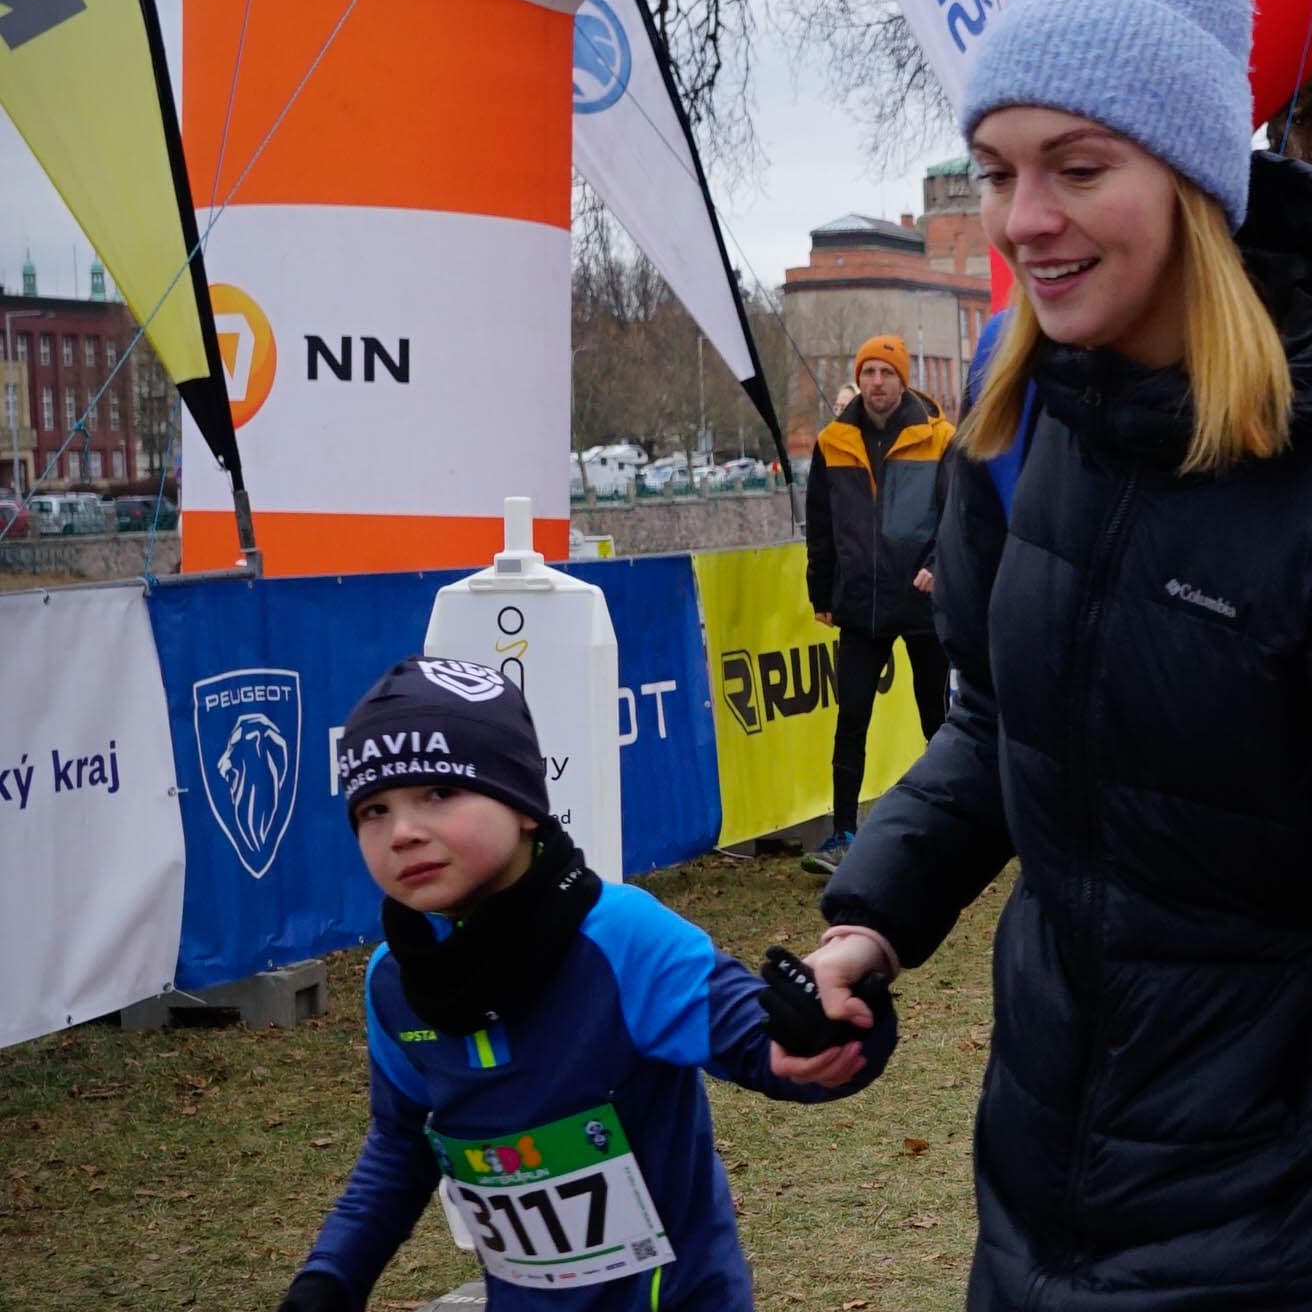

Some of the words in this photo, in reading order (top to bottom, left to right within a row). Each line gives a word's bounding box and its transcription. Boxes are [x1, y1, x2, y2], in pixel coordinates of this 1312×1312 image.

[304, 334, 410, 384] NN
[205, 685, 292, 713] PEUGEOT
[52, 740, 120, 794] kraj
[339, 731, 451, 778] SLAVIA
[381, 757, 478, 779] KRÁLOVÉ
[458, 1171, 608, 1257] 3117
